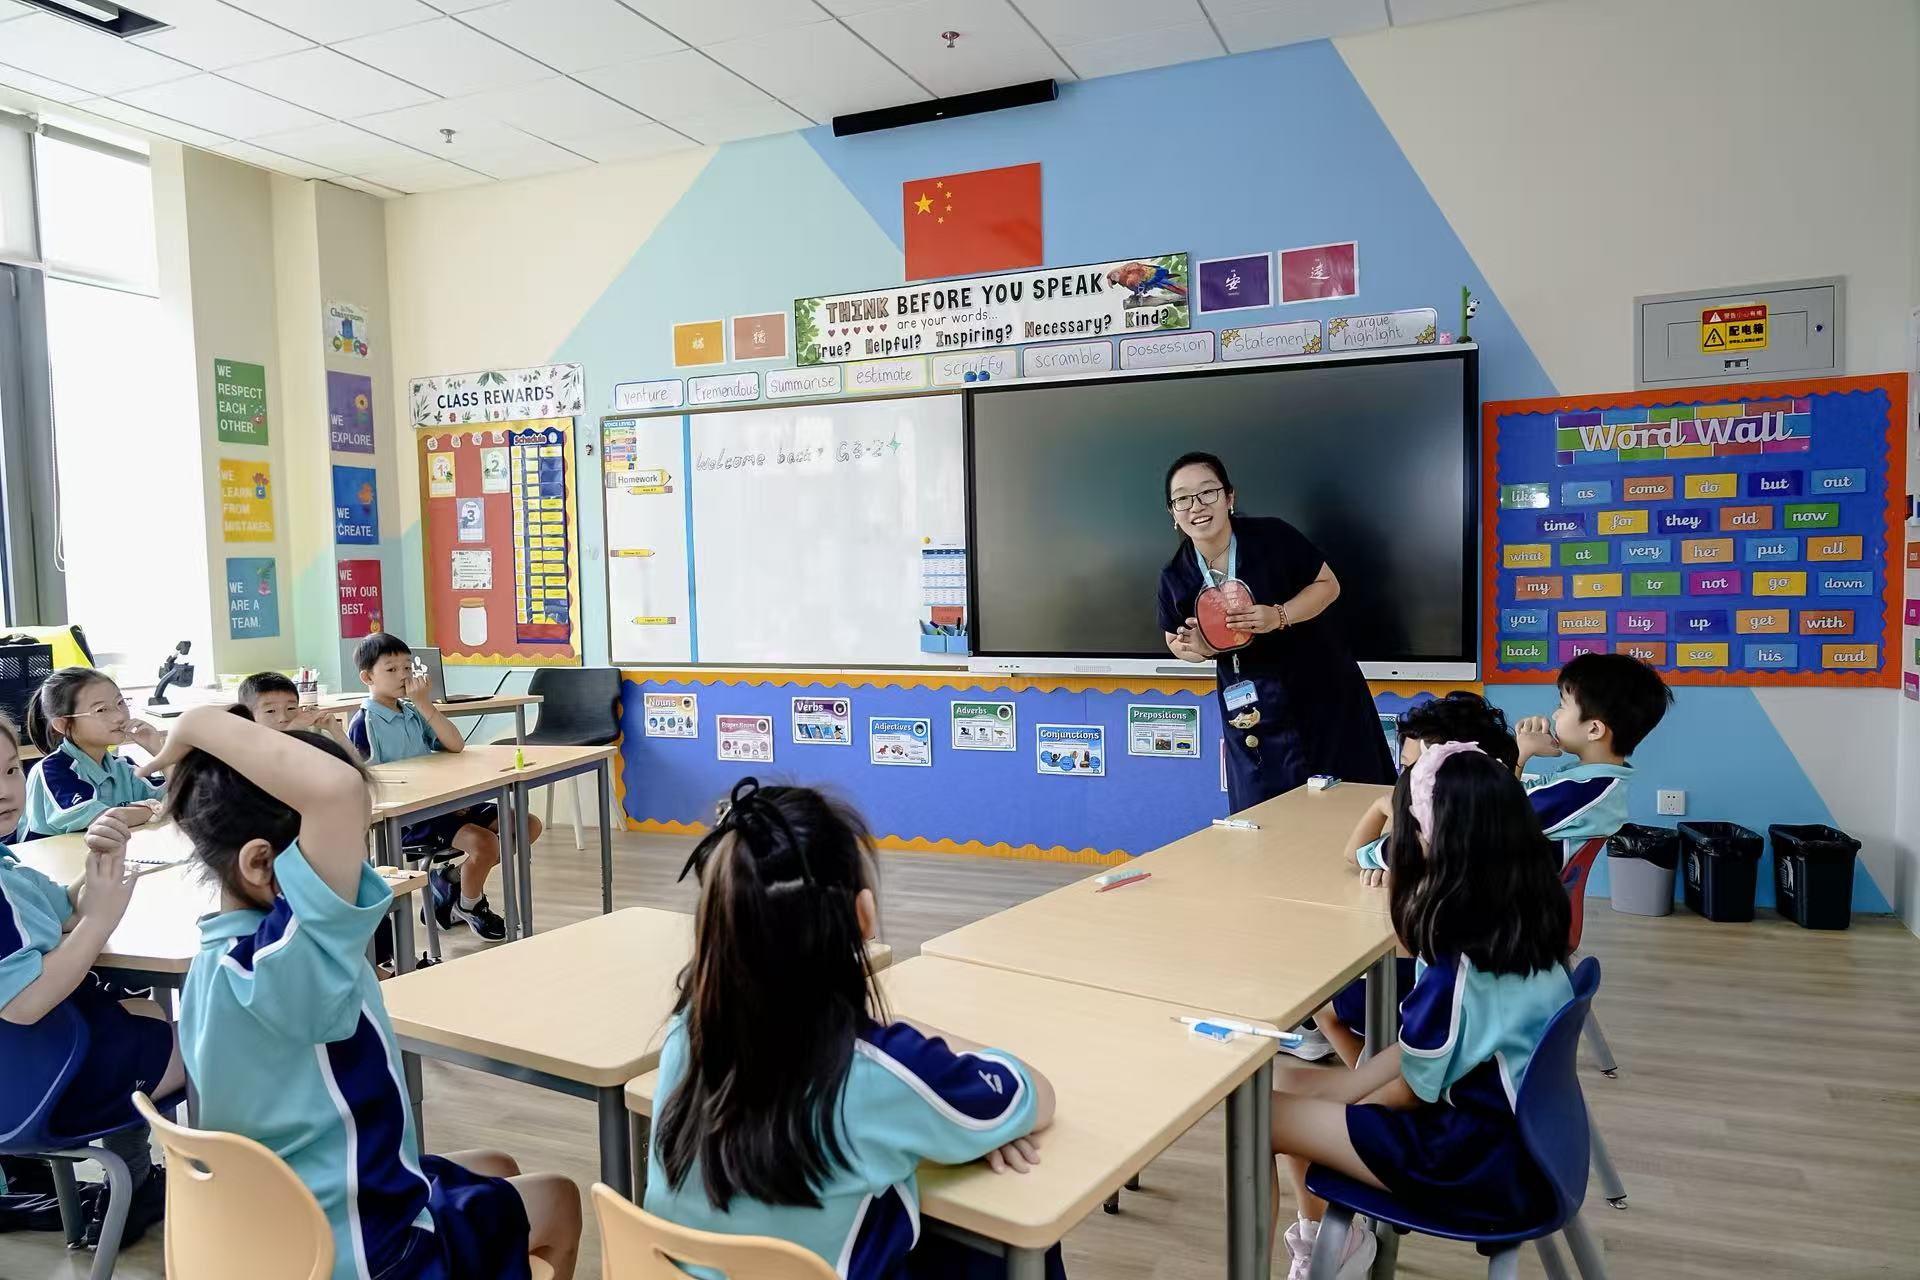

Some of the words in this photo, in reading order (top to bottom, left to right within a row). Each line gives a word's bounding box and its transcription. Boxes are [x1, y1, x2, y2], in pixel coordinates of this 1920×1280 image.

[1225, 273, 1241, 291] 安
[826, 297, 889, 324] THINK
[897, 287, 972, 315] BEFORE
[981, 281, 1023, 306] YOU
[1032, 272, 1104, 300] SPEAK
[897, 319, 917, 330] are
[920, 315, 947, 330] your
[951, 309, 998, 323] words...
[1356, 315, 1390, 328] argue
[814, 341, 852, 359] True?
[865, 334, 921, 355] Helpful?
[935, 324, 1013, 348] Inspiring?
[1024, 313, 1113, 338] Necessary?
[1124, 309, 1170, 329] Kind?
[1729, 323, 1764, 336] 配电箱
[1343, 326, 1403, 346] highlight
[1034, 347, 1101, 369] scramble
[217, 365, 231, 378] WE
[856, 364, 913, 384] estimate
[218, 383, 263, 399] RESPECT
[437, 391, 479, 409] CLASS
[484, 385, 554, 406] REWARDS
[623, 388, 669, 404] venture
[219, 401, 247, 414] EACH
[331, 414, 344, 426] WE
[220, 419, 256, 434] OTHER.
[1579, 418, 1687, 452] Word
[1693, 411, 1793, 446] Wall
[491, 460, 499, 472] 2
[617, 474, 658, 484] Homework
[1760, 478, 1790, 490] but
[1823, 476, 1853, 488] out
[1629, 484, 1667, 495] come
[1700, 481, 1720, 493] do
[1577, 488, 1596, 499] as
[337, 507, 350, 518] WE
[467, 510, 475, 522] 3
[1732, 512, 1760, 525] old
[1792, 511, 1829, 522] now
[1544, 519, 1578, 530] time
[1611, 515, 1634, 530] for
[1666, 514, 1702, 530] they
[338, 525, 374, 536] CREATE.
[1629, 546, 1663, 559] very
[1693, 546, 1720, 557] her
[1757, 543, 1787, 558] put
[1822, 542, 1846, 554] all
[1509, 551, 1544, 562] what
[1575, 549, 1593, 560] at
[339, 569, 353, 581] WE
[229, 582, 244, 593] WE
[1527, 582, 1552, 595] my
[1592, 581, 1604, 591] a
[1647, 579, 1664, 590] to
[1701, 578, 1729, 589] not
[1768, 578, 1790, 591] go
[1824, 577, 1865, 589] down
[340, 586, 357, 597] TRY
[360, 586, 378, 597] OUR
[231, 600, 250, 611] ARE
[254, 600, 260, 610] A
[341, 603, 367, 615] BEST.
[232, 617, 261, 629] TEAM.
[1510, 614, 1538, 626] you
[1562, 616, 1601, 628] make
[1628, 616, 1654, 631] big
[1690, 618, 1712, 631] up
[1750, 615, 1776, 629] get
[1806, 615, 1847, 629] with
[1507, 644, 1542, 657] back
[1573, 645, 1590, 655] he
[1629, 648, 1656, 659] the
[1690, 652, 1713, 660] see
[1758, 650, 1784, 662] his
[1833, 650, 1867, 662] and
[648, 698, 677, 708] Nouns
[796, 702, 824, 712] Verbs
[956, 706, 988, 715] Adverbs
[1133, 710, 1187, 720] Prepositions
[874, 722, 912, 733] Adjectives
[1040, 729, 1100, 742] Conjunctions
